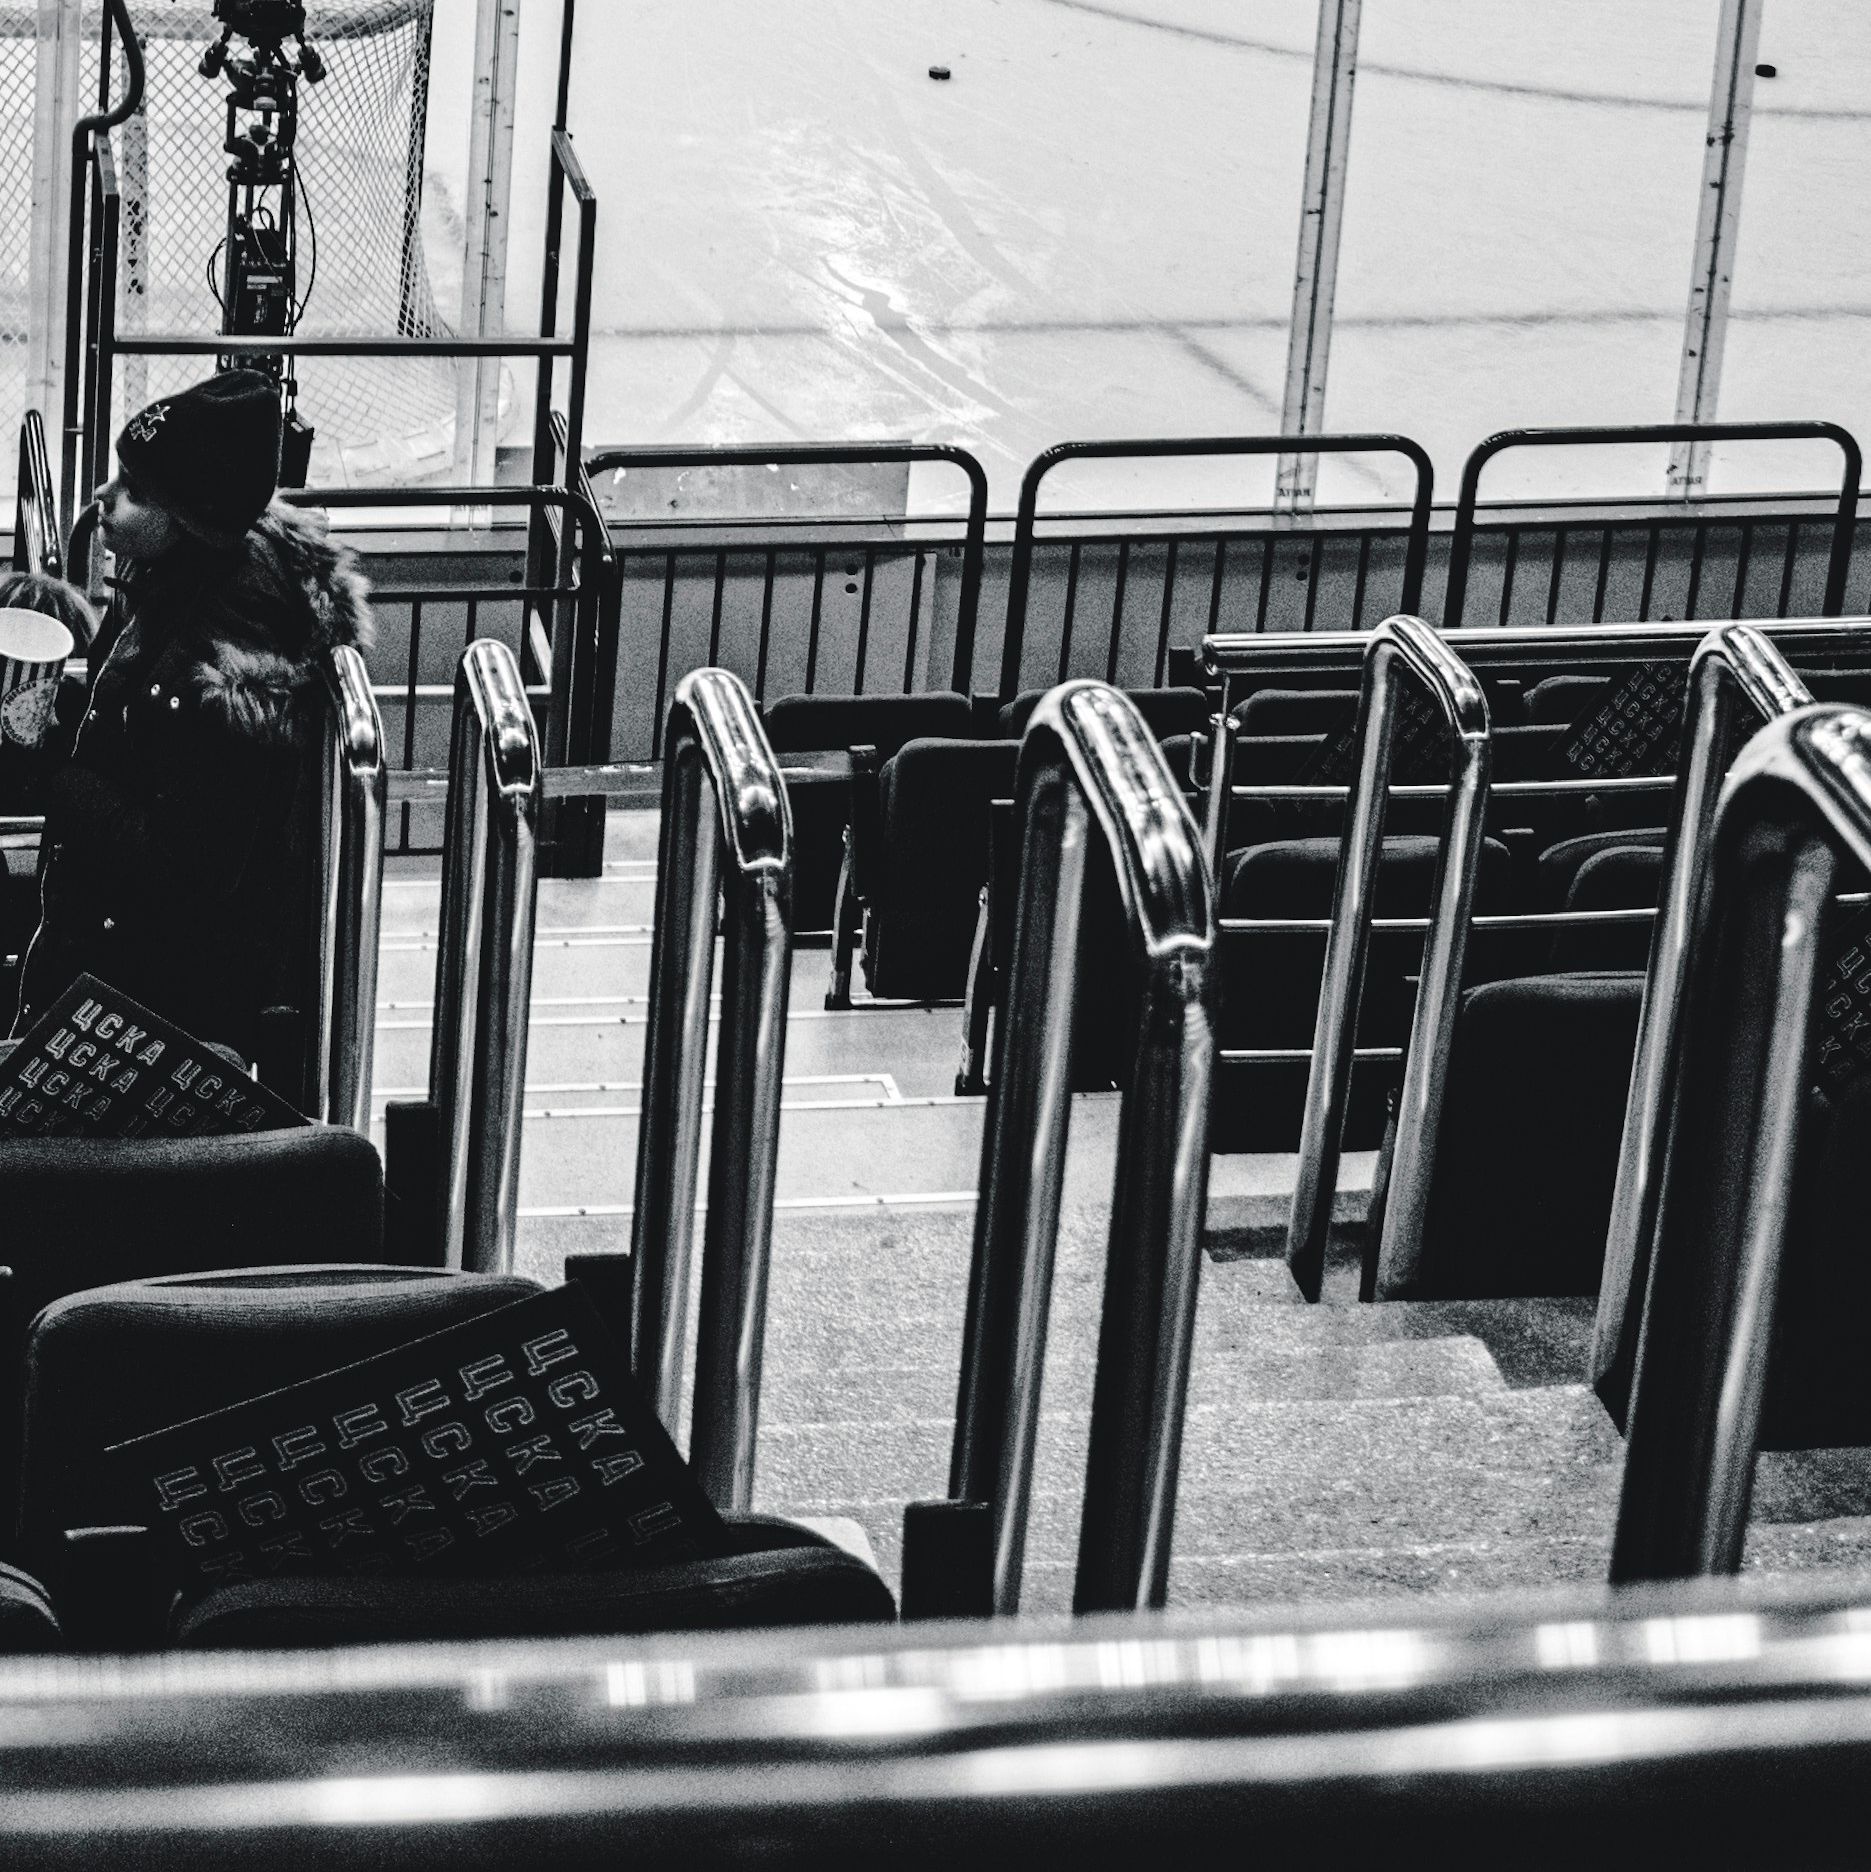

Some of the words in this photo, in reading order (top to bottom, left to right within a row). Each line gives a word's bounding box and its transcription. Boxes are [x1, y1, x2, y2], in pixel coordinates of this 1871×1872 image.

[19, 1057, 111, 1120] ЦСКА
[45, 1028, 138, 1093] ЦСКА
[72, 998, 165, 1065] ЦСКА
[171, 1059, 265, 1129] ЦСКА
[391, 1378, 514, 1537] ЦСКА
[455, 1353, 576, 1511] ЦСКА
[517, 1328, 640, 1485] ЦСКА
